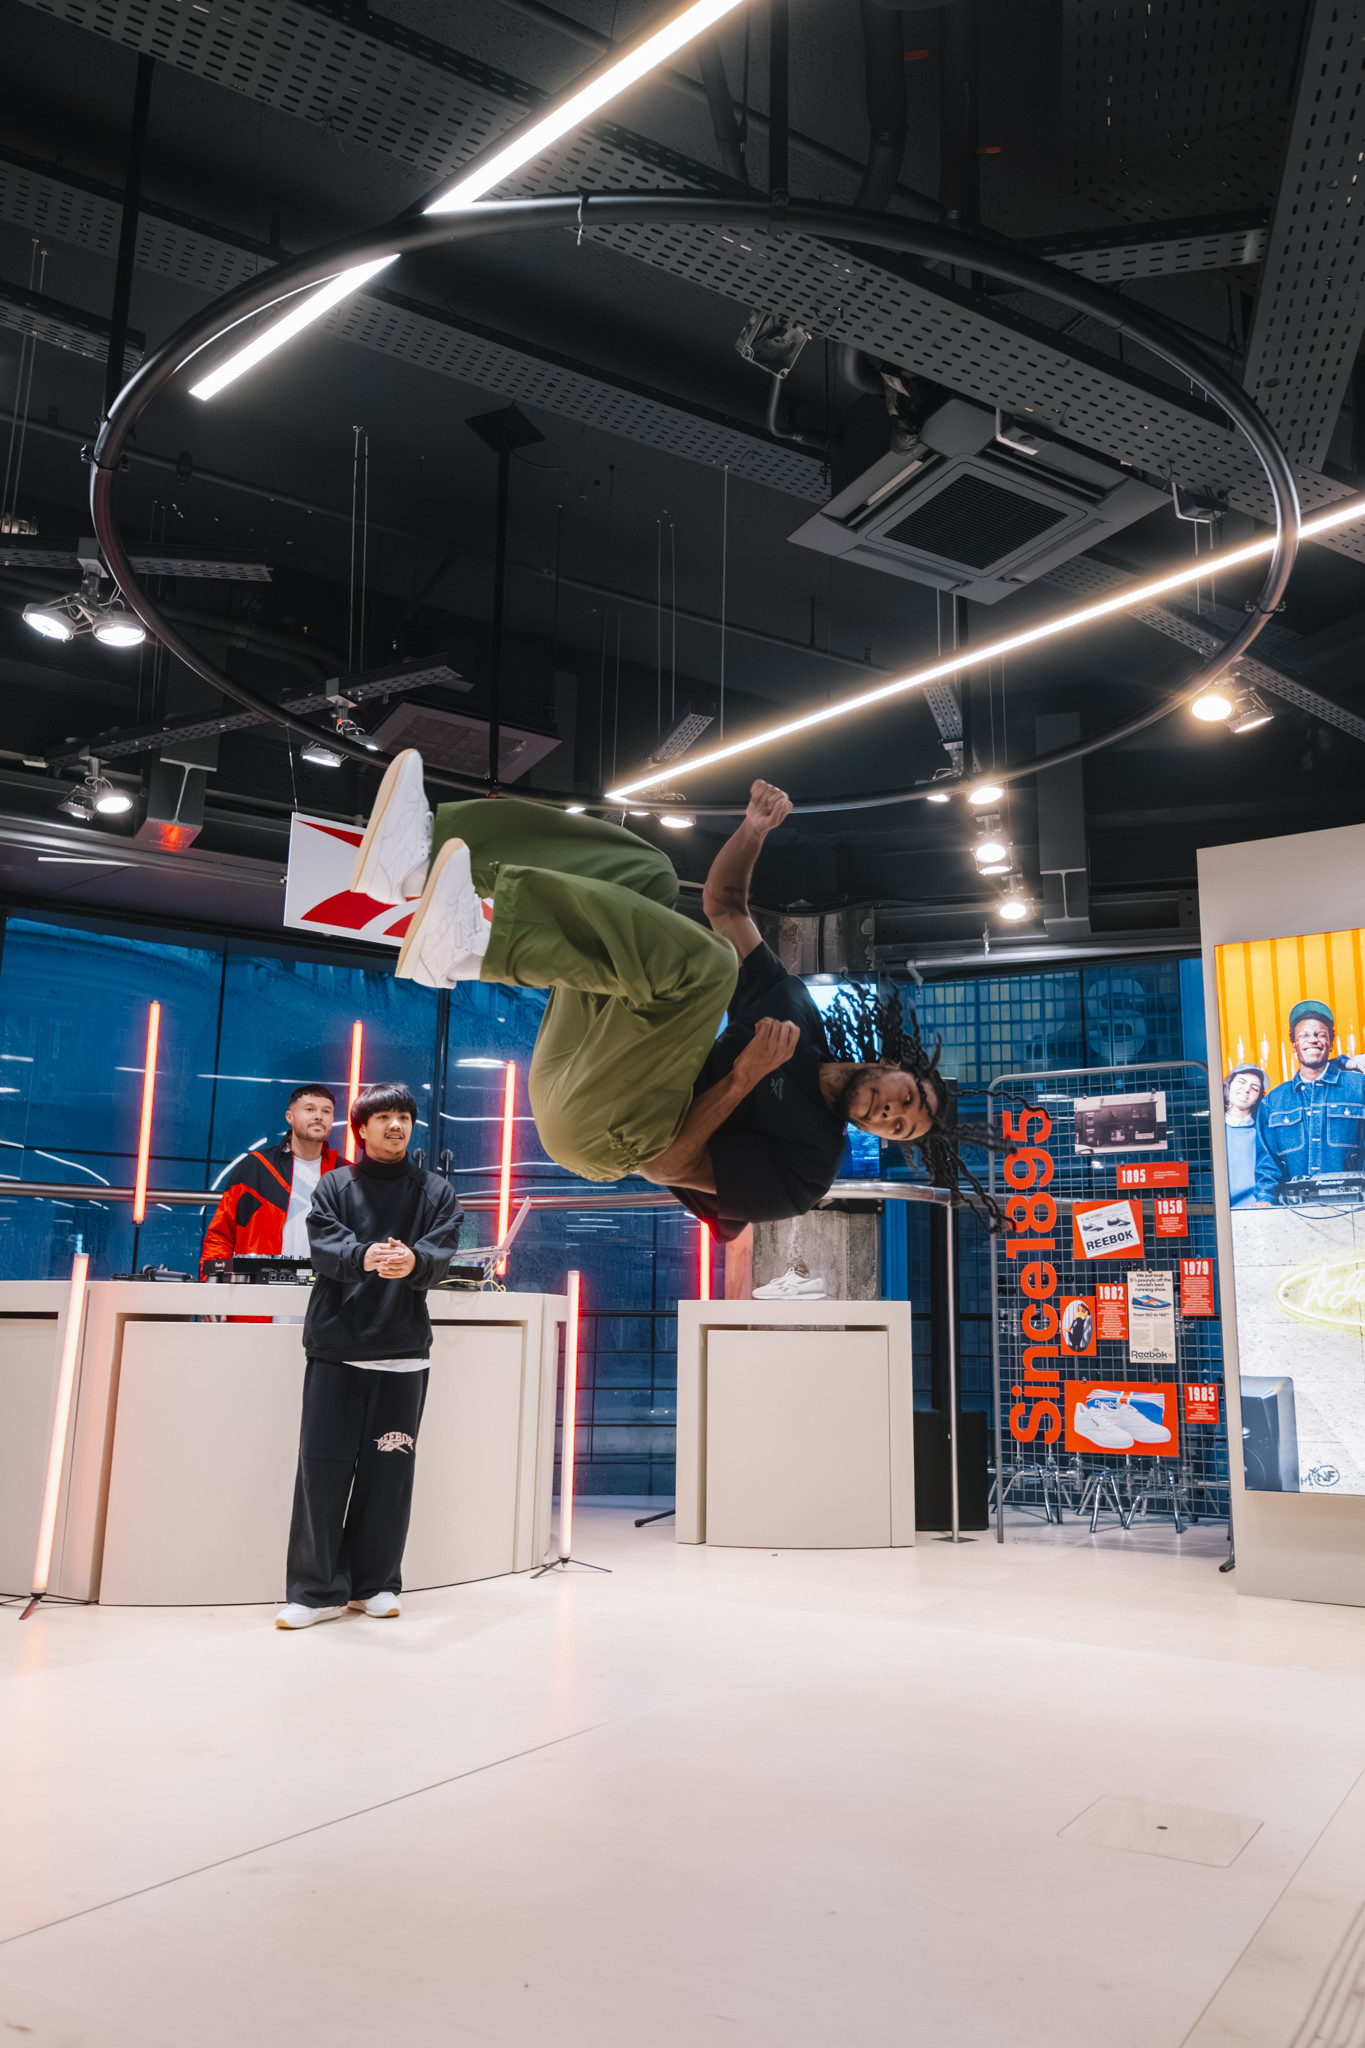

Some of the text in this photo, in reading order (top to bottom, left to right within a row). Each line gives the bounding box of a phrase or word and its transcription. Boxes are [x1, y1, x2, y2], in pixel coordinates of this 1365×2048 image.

[1122, 1169, 1146, 1183] 1895
[1158, 1200, 1183, 1214] 1958
[1086, 1230, 1134, 1250] REEBOK
[1183, 1261, 1209, 1275] 1979
[1099, 1286, 1124, 1300] 1982
[1131, 1350, 1168, 1359] Reebok
[1188, 1387, 1215, 1402] 1985
